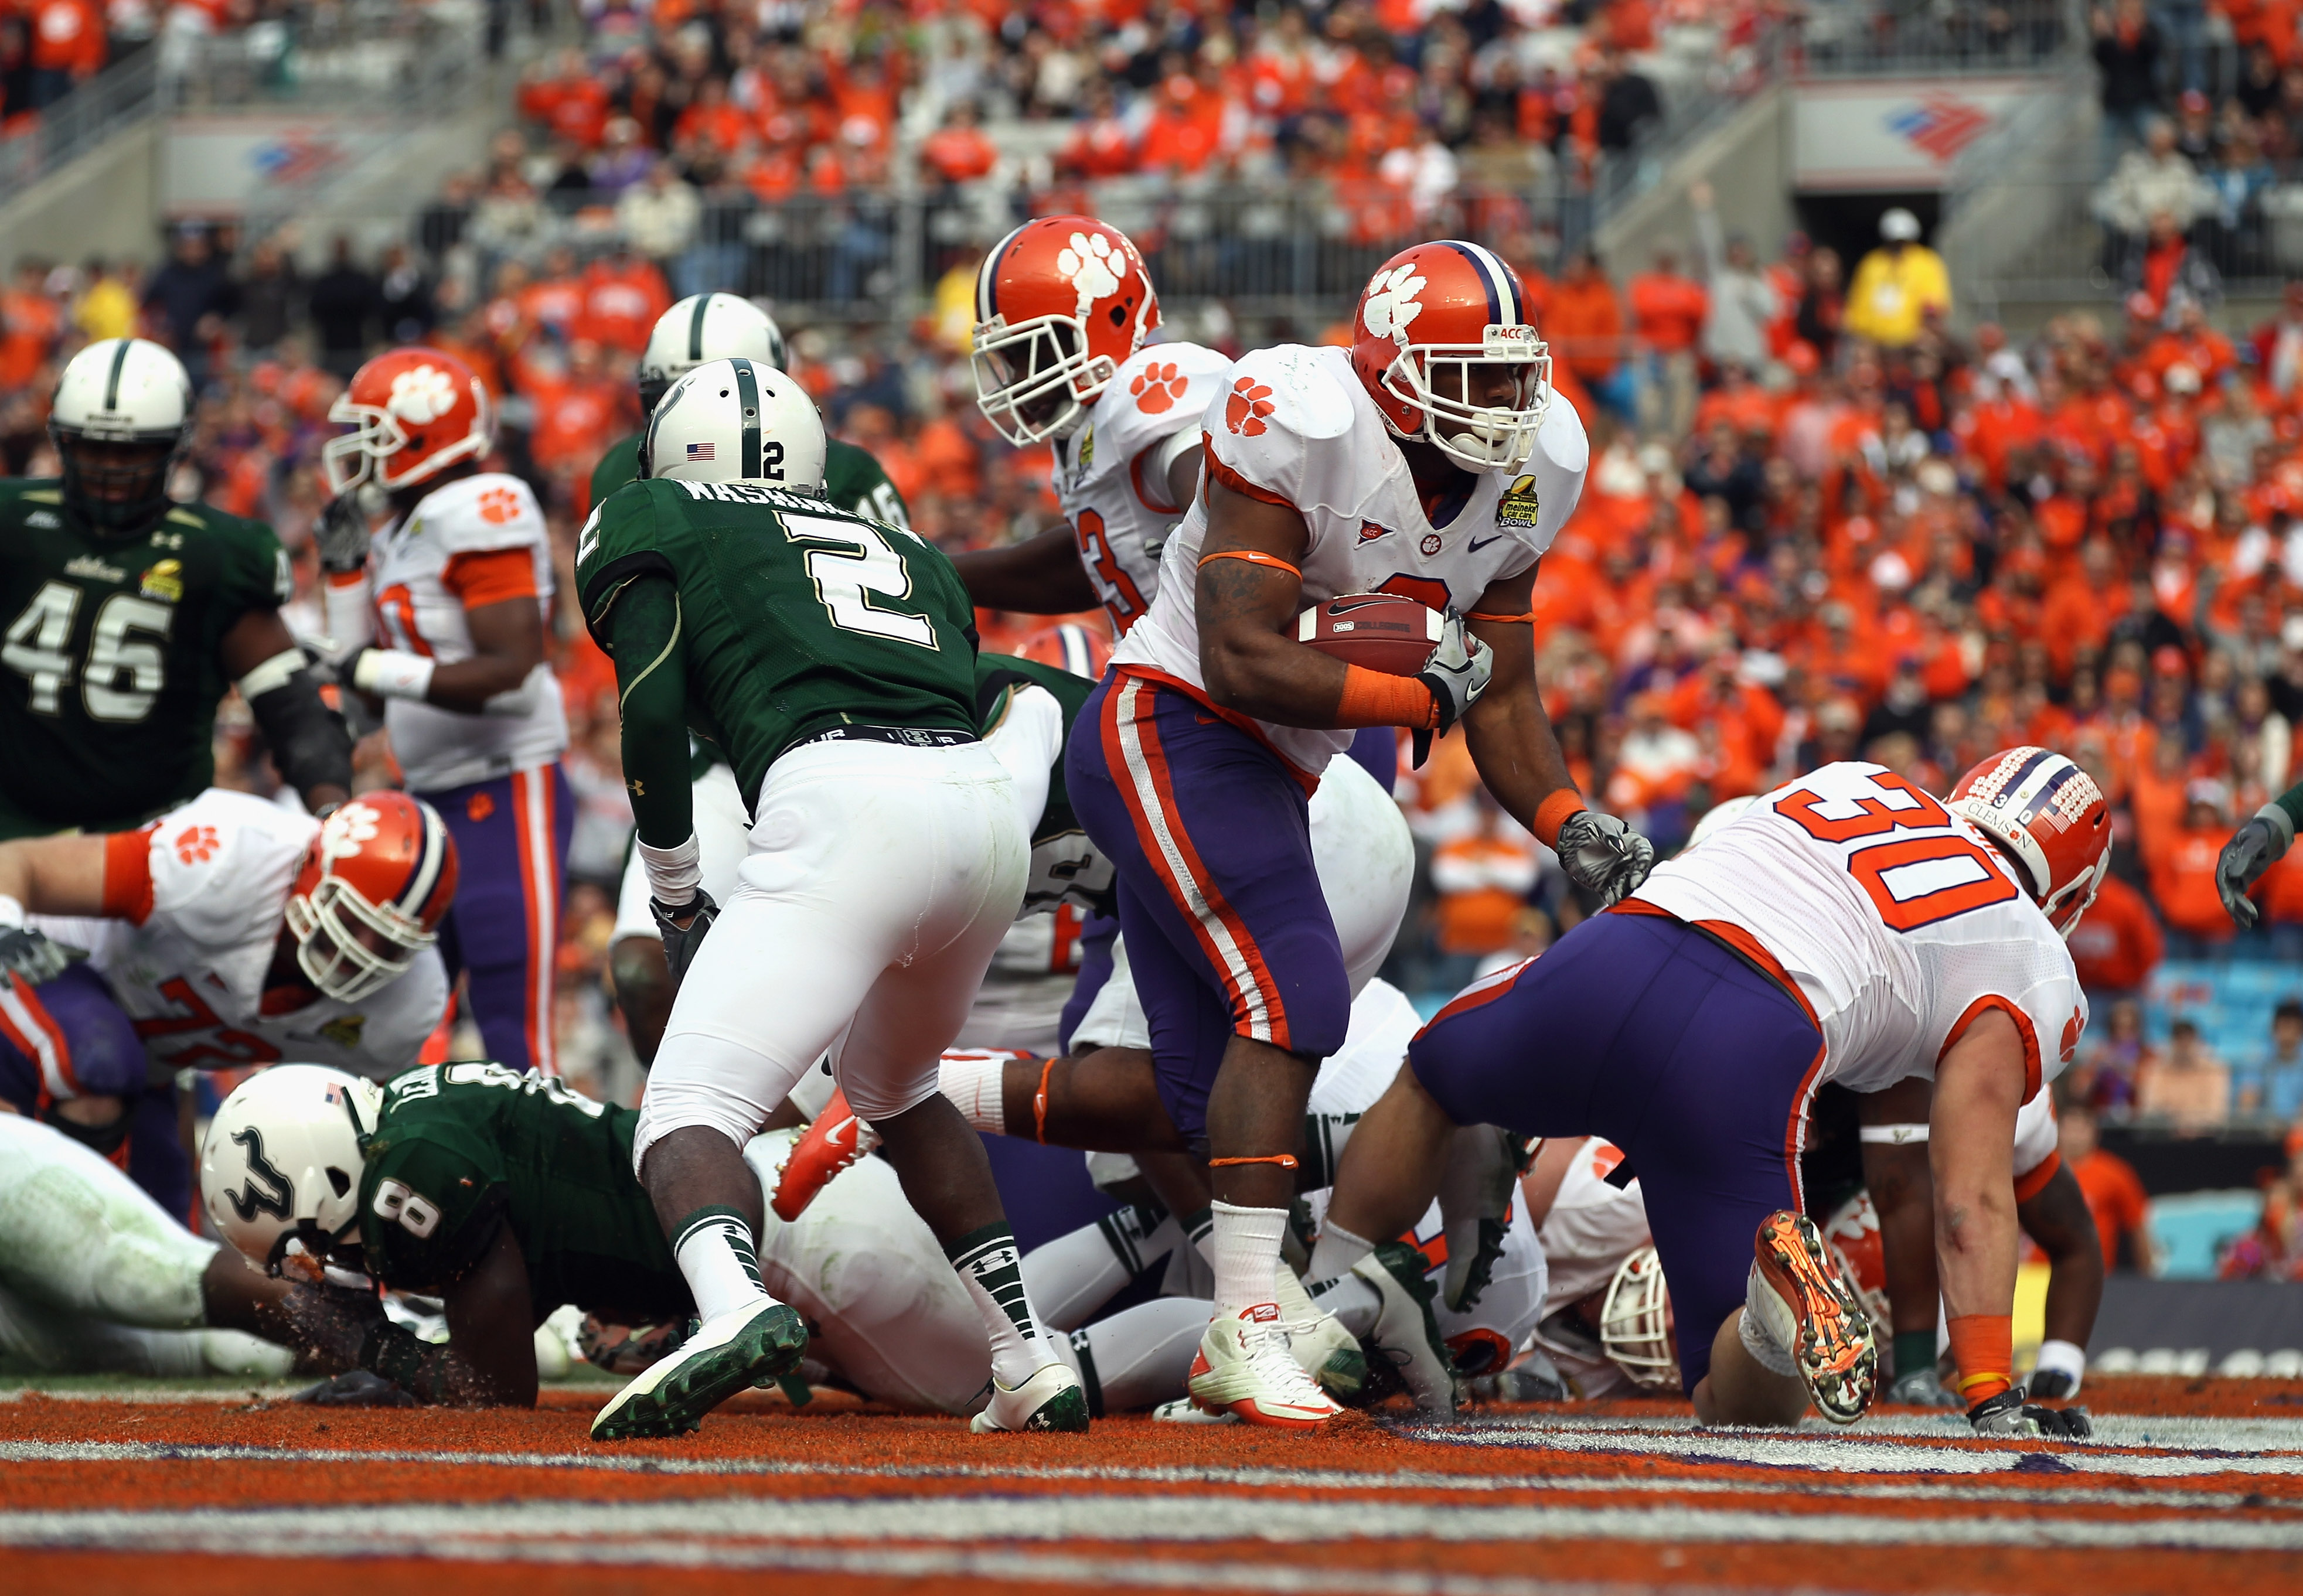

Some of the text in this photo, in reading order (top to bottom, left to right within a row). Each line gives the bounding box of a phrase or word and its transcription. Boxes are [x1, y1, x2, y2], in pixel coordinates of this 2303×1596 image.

[1500, 328, 1522, 339] ACC
[763, 441, 784, 480] 2
[1500, 517, 1533, 527] BOWL
[772, 510, 941, 653] 2
[1, 578, 174, 724] 46
[1994, 793, 2009, 809] 3
[1773, 770, 2019, 934] 30
